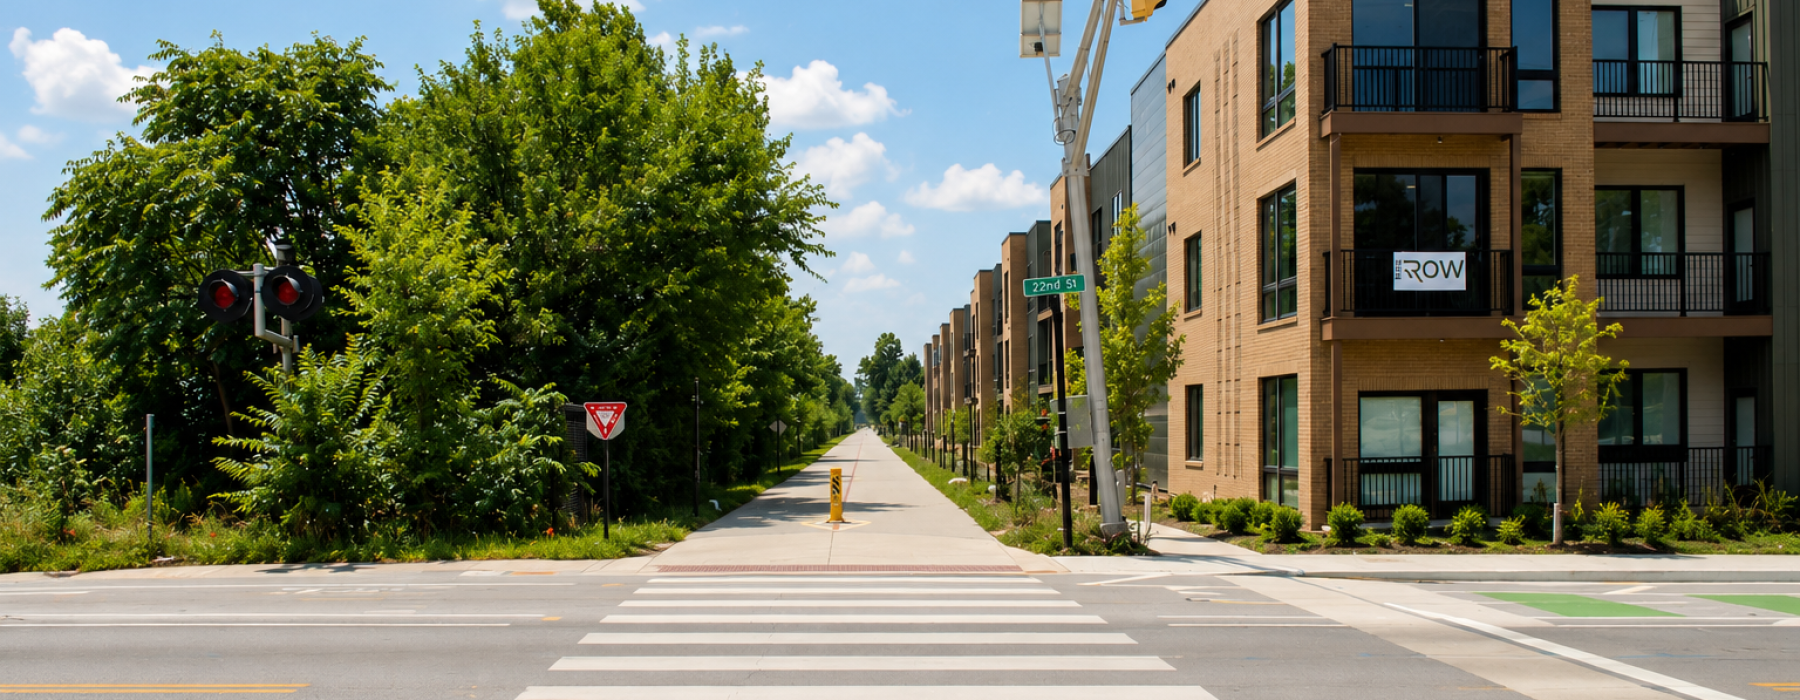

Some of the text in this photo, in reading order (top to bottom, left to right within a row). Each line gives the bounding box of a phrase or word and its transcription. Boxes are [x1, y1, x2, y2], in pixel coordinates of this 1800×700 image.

[1403, 260, 1464, 283] ROW
[1032, 278, 1077, 292] 22nd St
